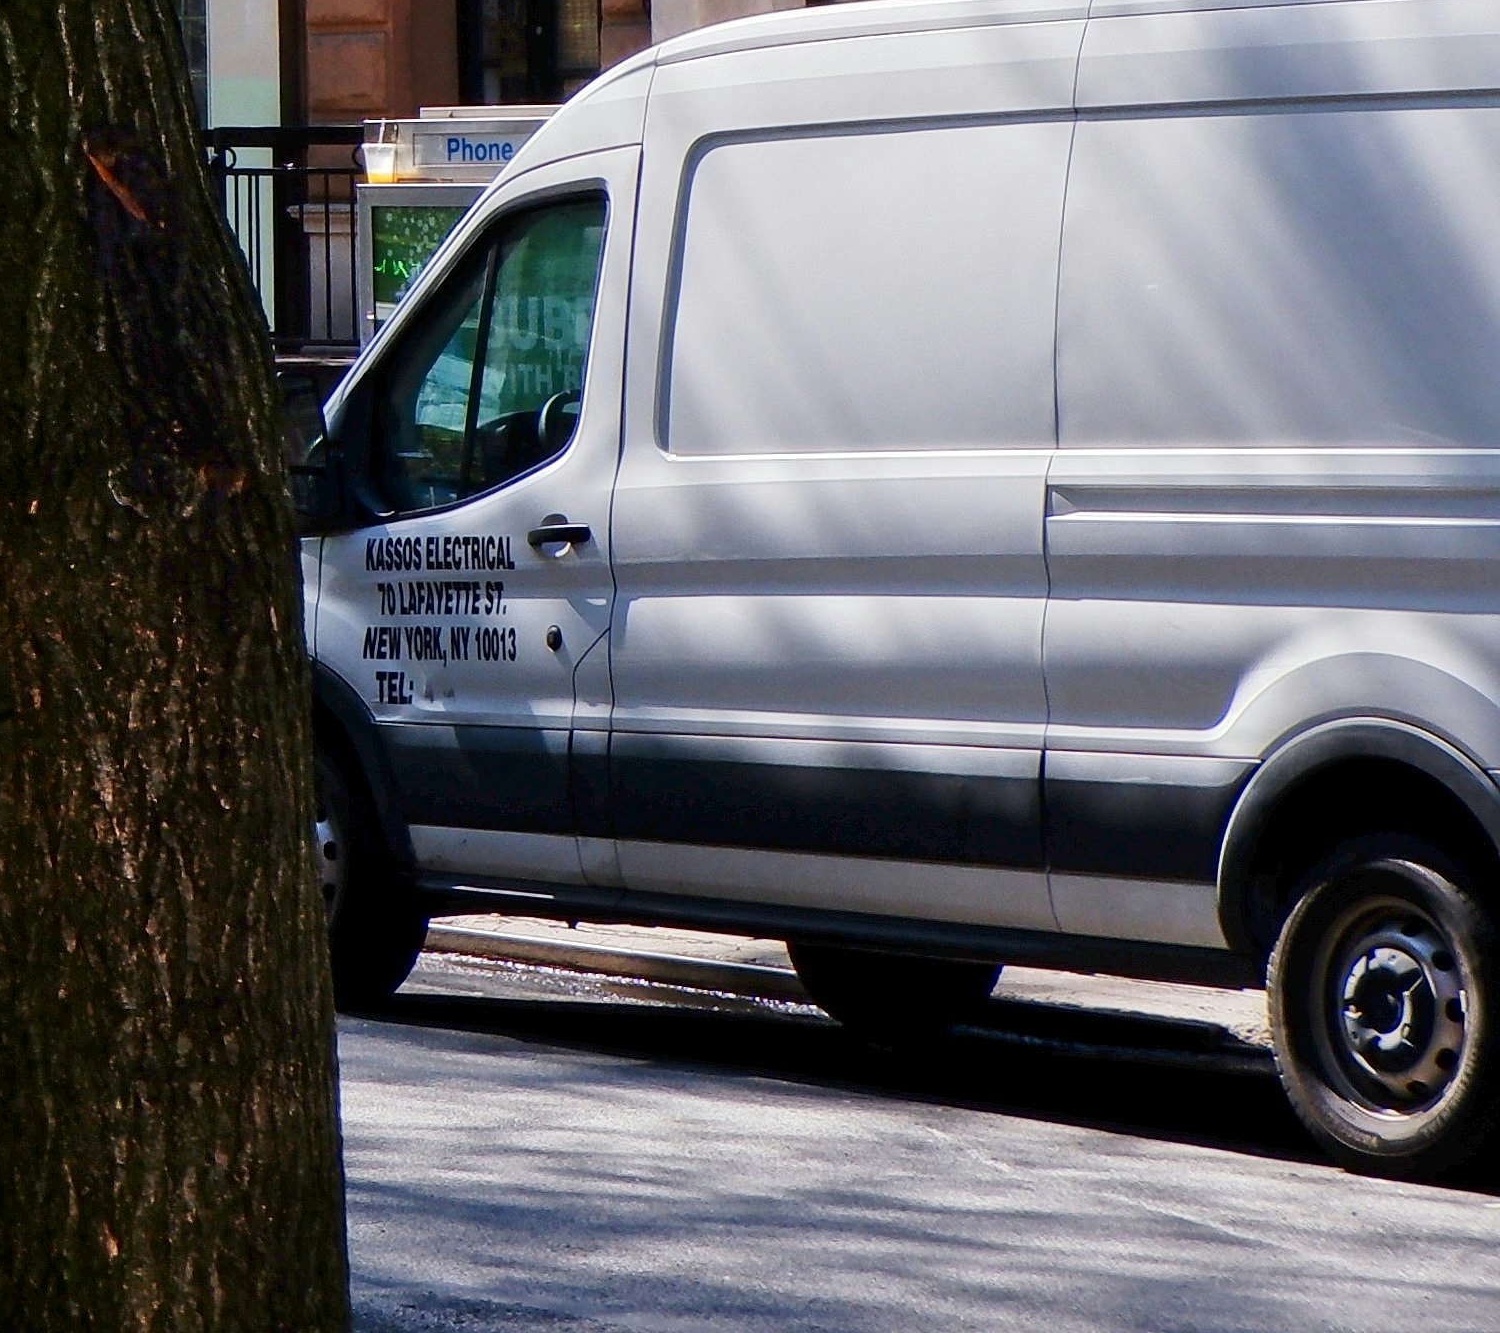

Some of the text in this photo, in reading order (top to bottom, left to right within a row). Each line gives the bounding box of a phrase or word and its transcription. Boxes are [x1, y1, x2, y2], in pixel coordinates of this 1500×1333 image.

[447, 137, 514, 163] Phone
[365, 535, 516, 572] KASSOS ELECTRICAL
[377, 581, 507, 616] 70 LAFAYETTE ST.
[362, 625, 518, 668] NEW YORK, NY 10013
[375, 671, 414, 705] TEL:
